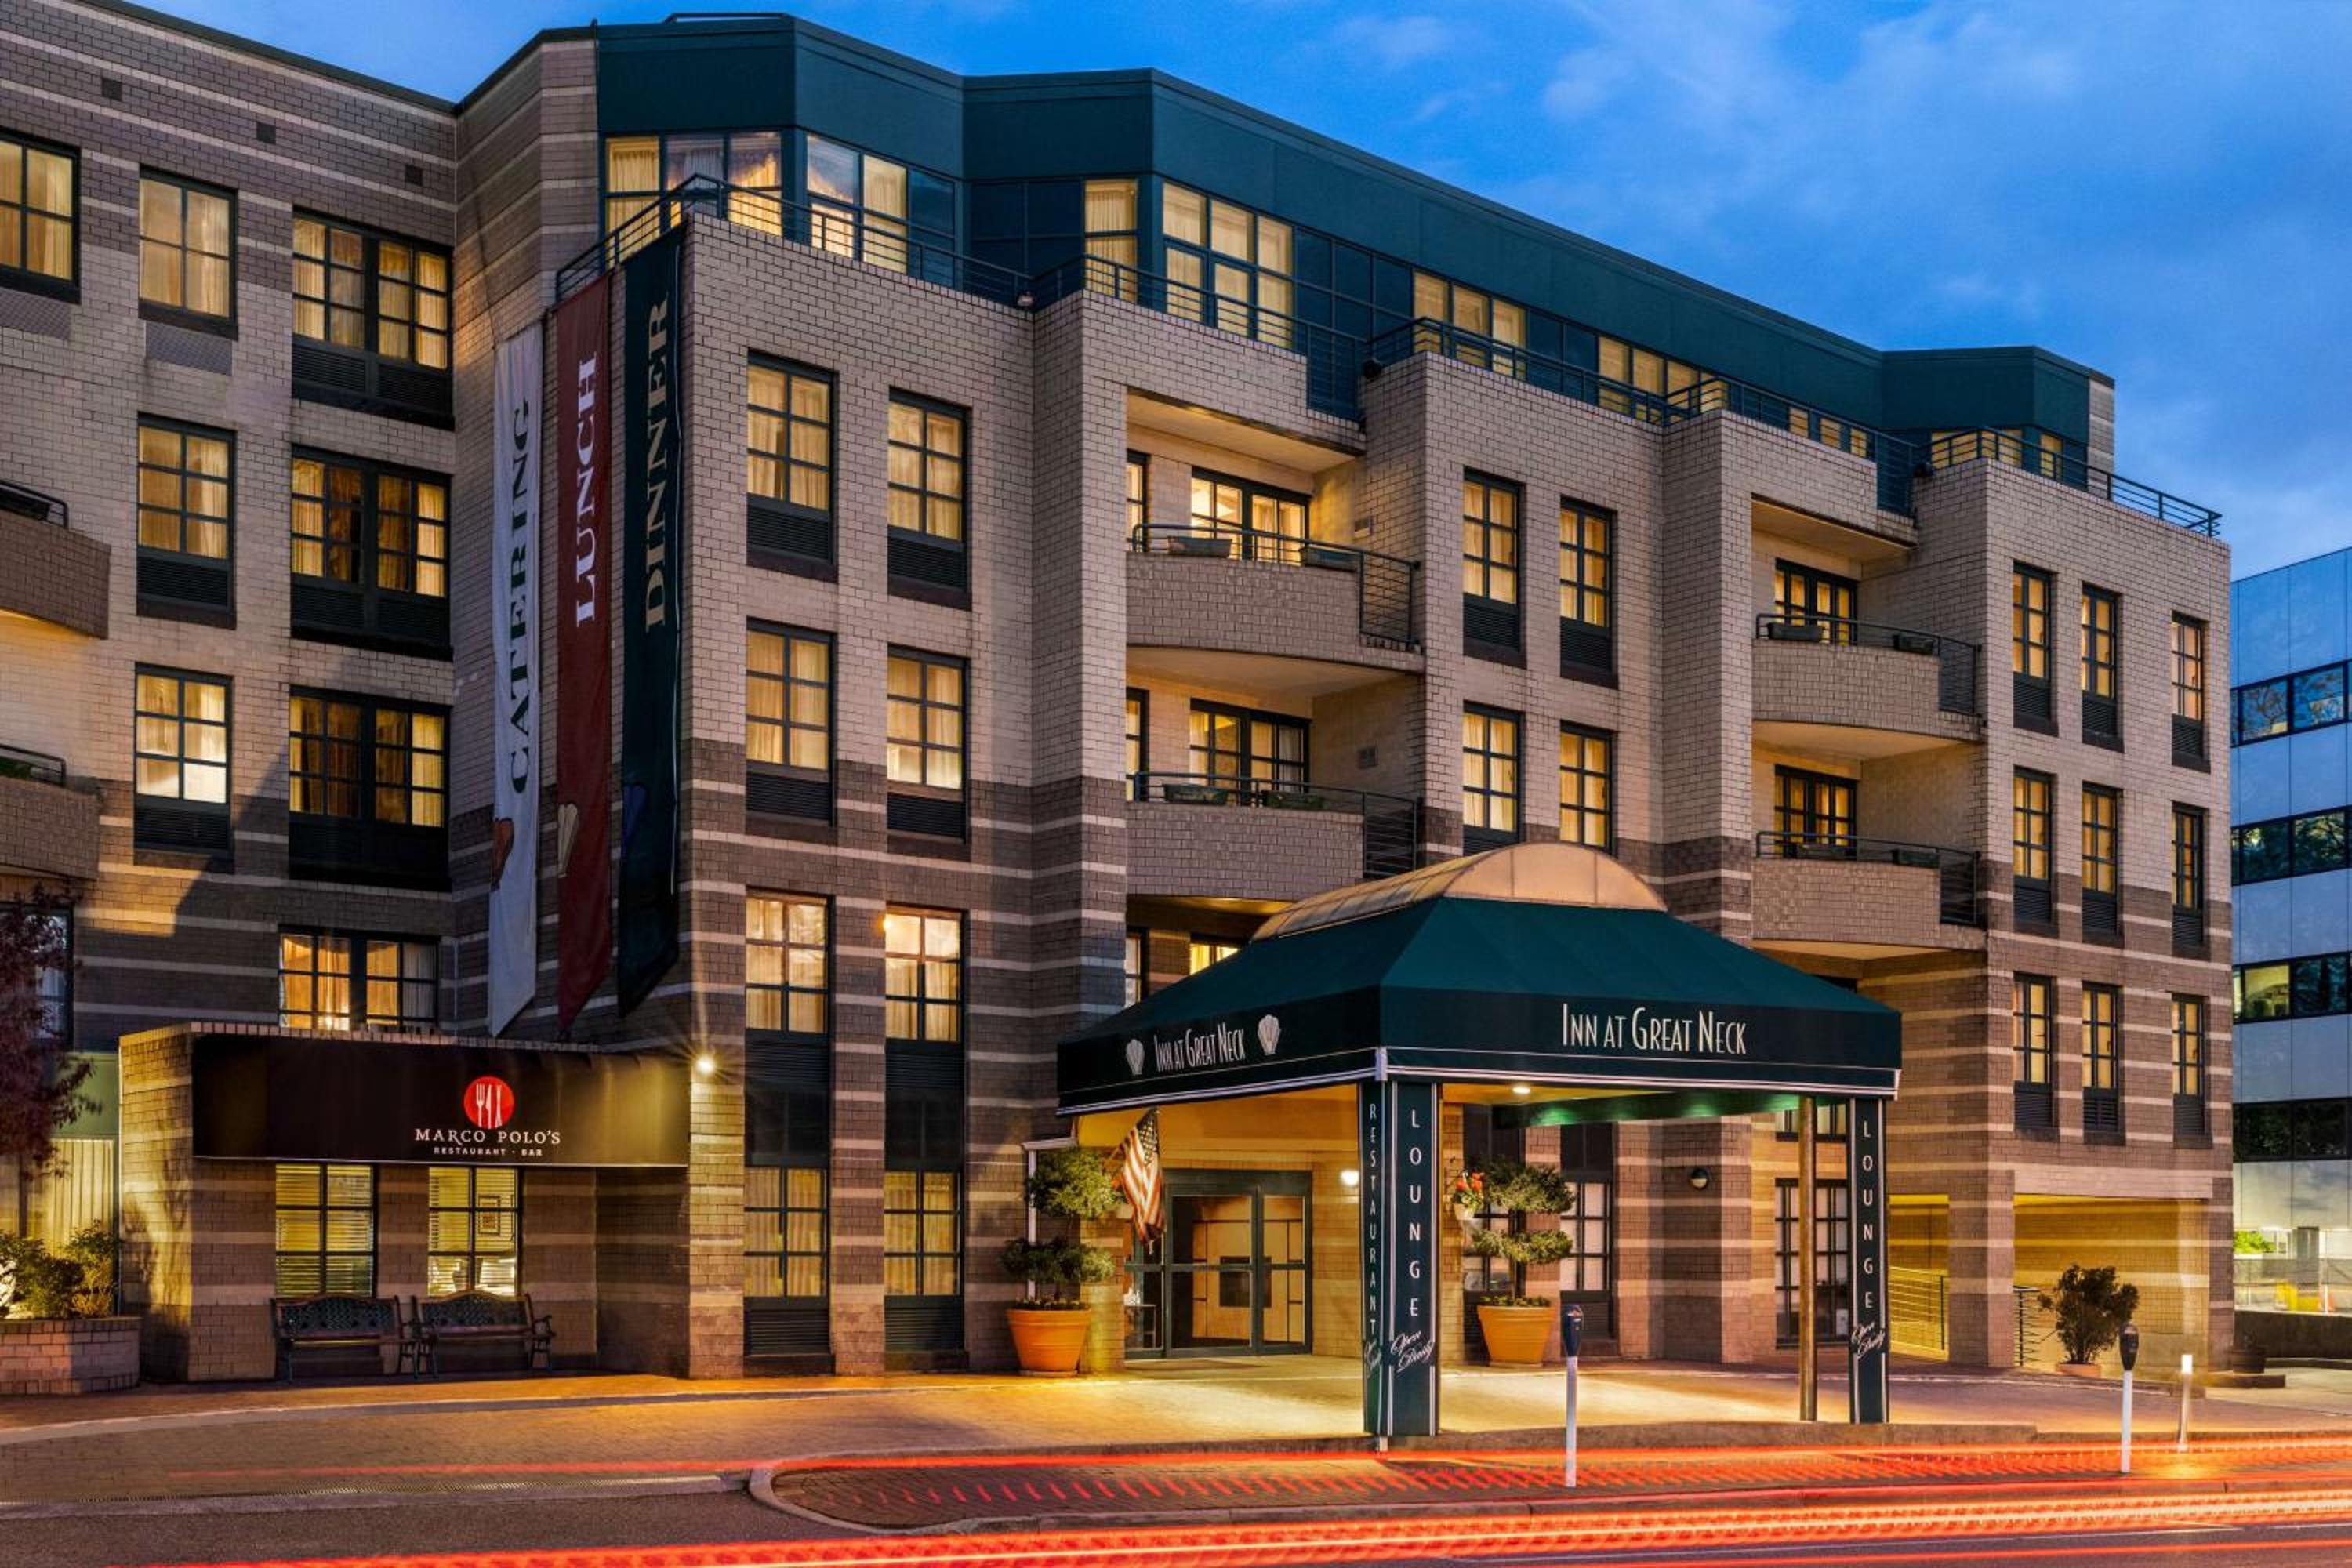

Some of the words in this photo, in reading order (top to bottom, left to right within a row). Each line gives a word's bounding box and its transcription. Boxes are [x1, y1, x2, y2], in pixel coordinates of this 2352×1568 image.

[576, 351, 597, 628] LUNCH
[645, 291, 668, 633] DINNER
[510, 397, 529, 794] CATERING
[1153, 1034, 1174, 1073] INN
[1174, 1040, 1185, 1070] AT
[1185, 1028, 1216, 1067] GREAT
[1217, 1022, 1246, 1065] NECK
[1563, 1003, 1598, 1047] INN
[1604, 1015, 1627, 1048] AT
[1632, 1007, 1693, 1052] GREAT
[1698, 1010, 1747, 1054] NECK
[415, 1128, 485, 1145] MARCO
[498, 1130, 561, 1145] POLO'S
[434, 1147, 506, 1156] RESTAURANT
[1367, 1103, 1377, 1335] RESTAURANT
[1410, 1109, 1421, 1317] LOUNGE
[1862, 1120, 1873, 1308] LOUNGE
